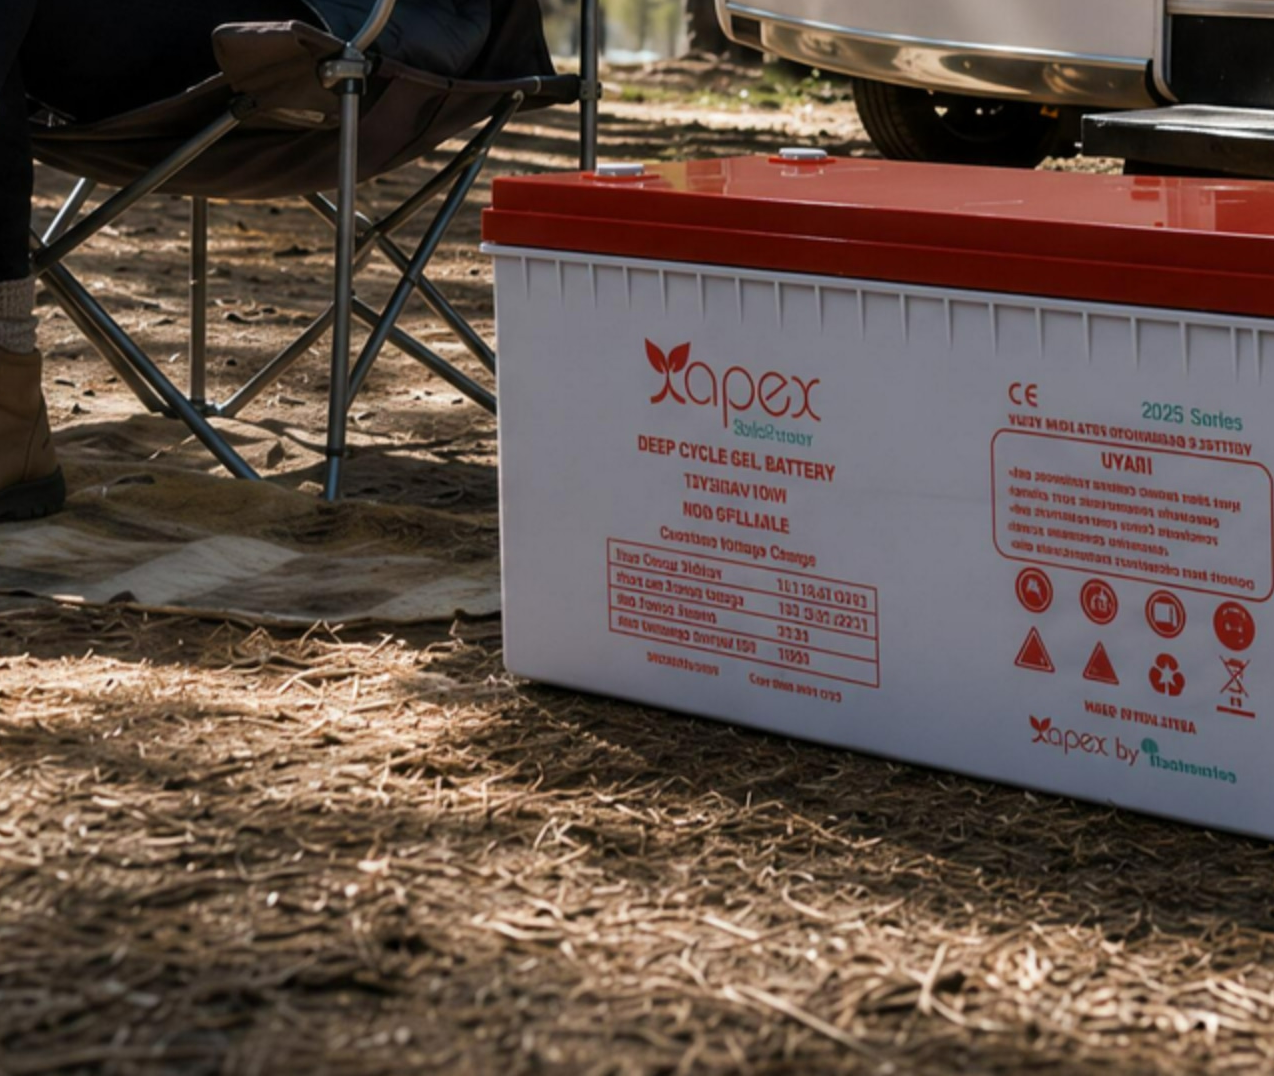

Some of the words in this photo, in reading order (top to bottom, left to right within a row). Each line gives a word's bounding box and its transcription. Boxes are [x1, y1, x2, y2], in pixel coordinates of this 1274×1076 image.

[1141, 401, 1184, 425] 2025
[637, 434, 676, 456] DEEP
[678, 441, 728, 466] CYCLE
[765, 455, 836, 483] BATTERY
[1115, 737, 1140, 767] by
